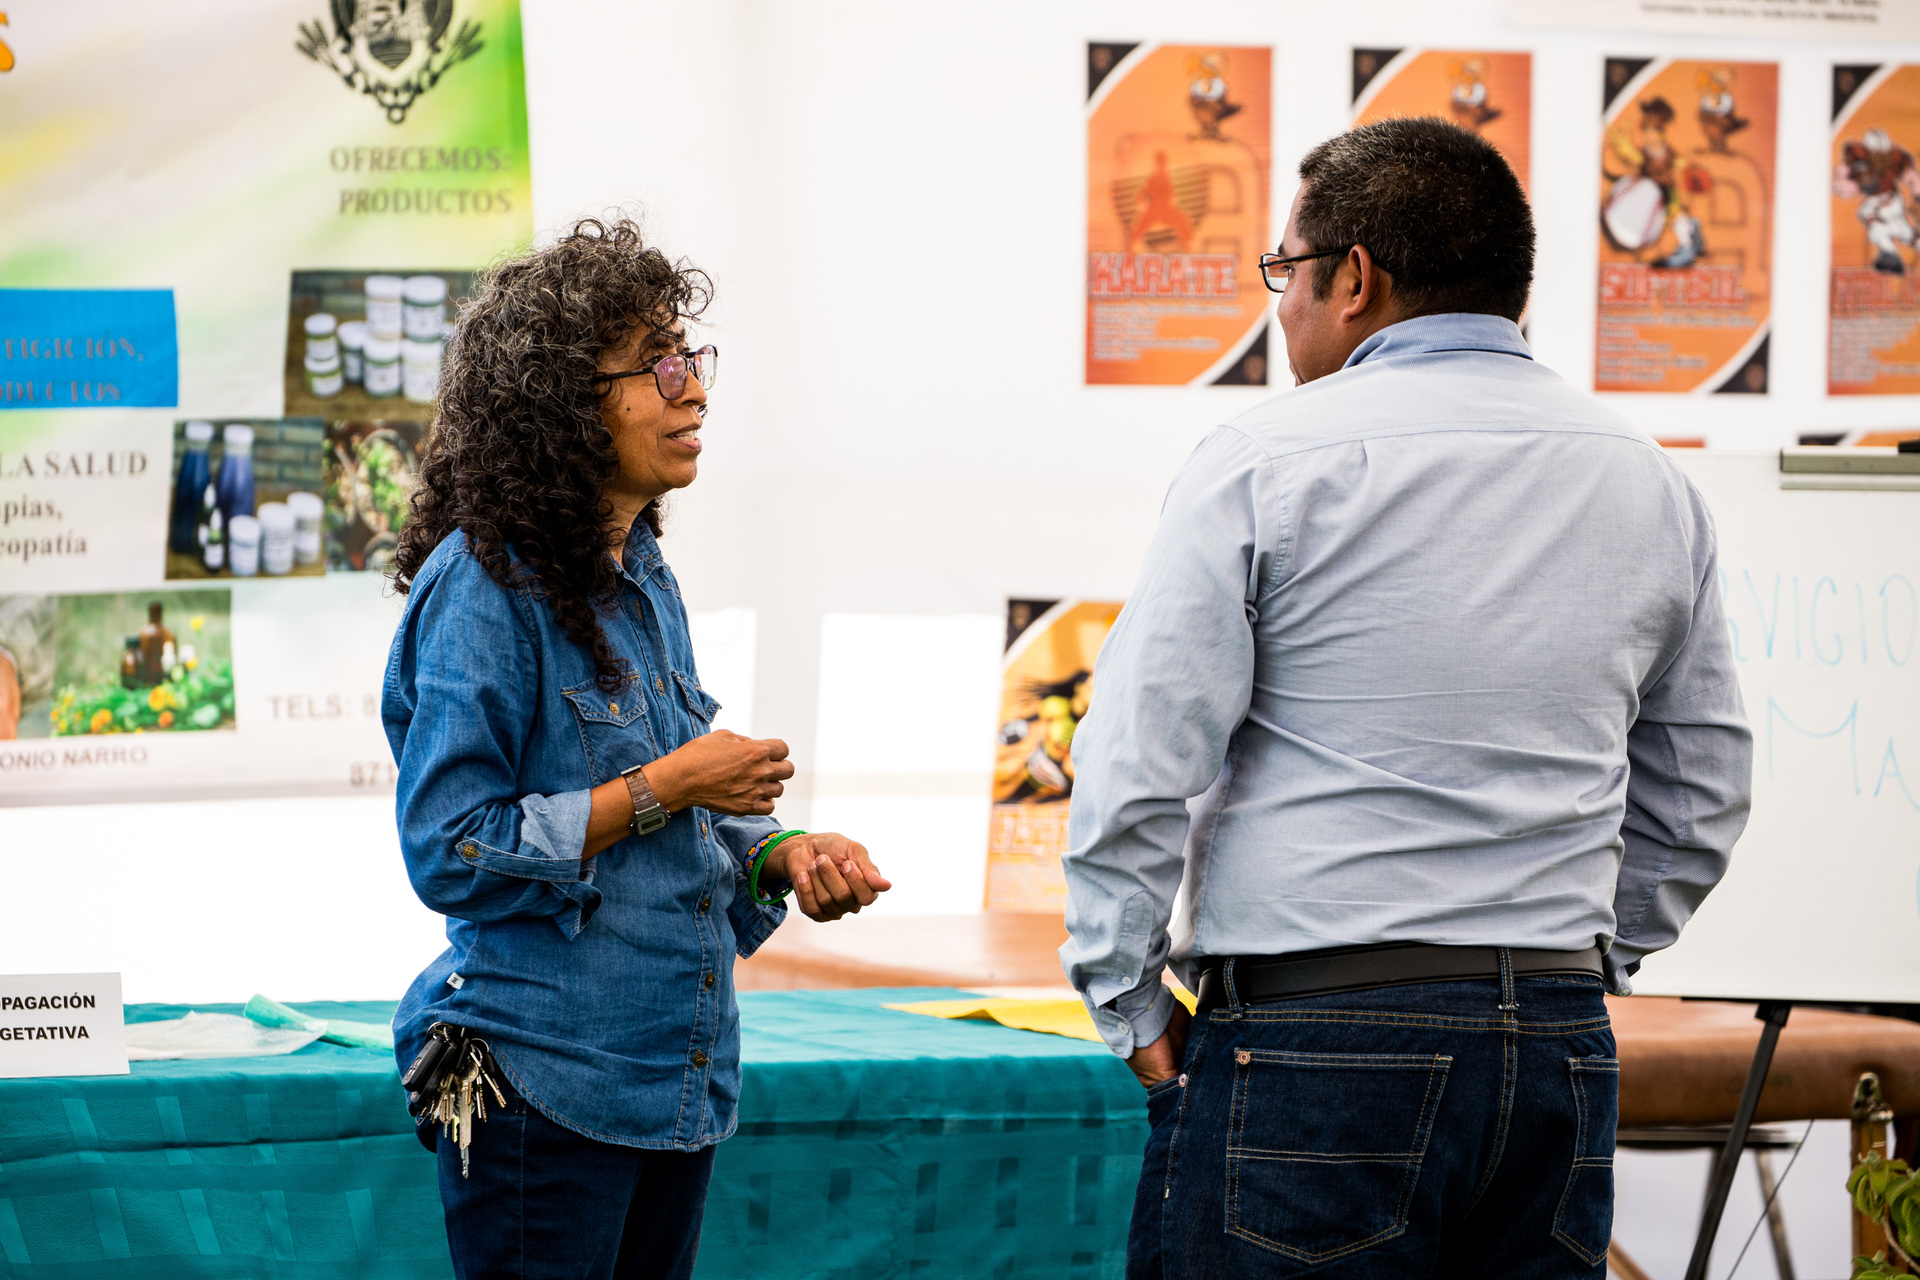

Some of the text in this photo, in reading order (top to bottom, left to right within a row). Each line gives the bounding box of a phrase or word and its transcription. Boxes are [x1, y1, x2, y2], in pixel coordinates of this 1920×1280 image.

[330, 146, 512, 172] OFRECEMOS:
[339, 188, 512, 215] PRODUCTOS
[1088, 253, 1238, 297] KARATE
[0, 380, 120, 402] DUCTOS
[45, 450, 147, 476] SALUD
[269, 694, 351, 719] TELS:
[63, 746, 147, 765] NARRO
[0, 992, 95, 1010] PAGACIÓN
